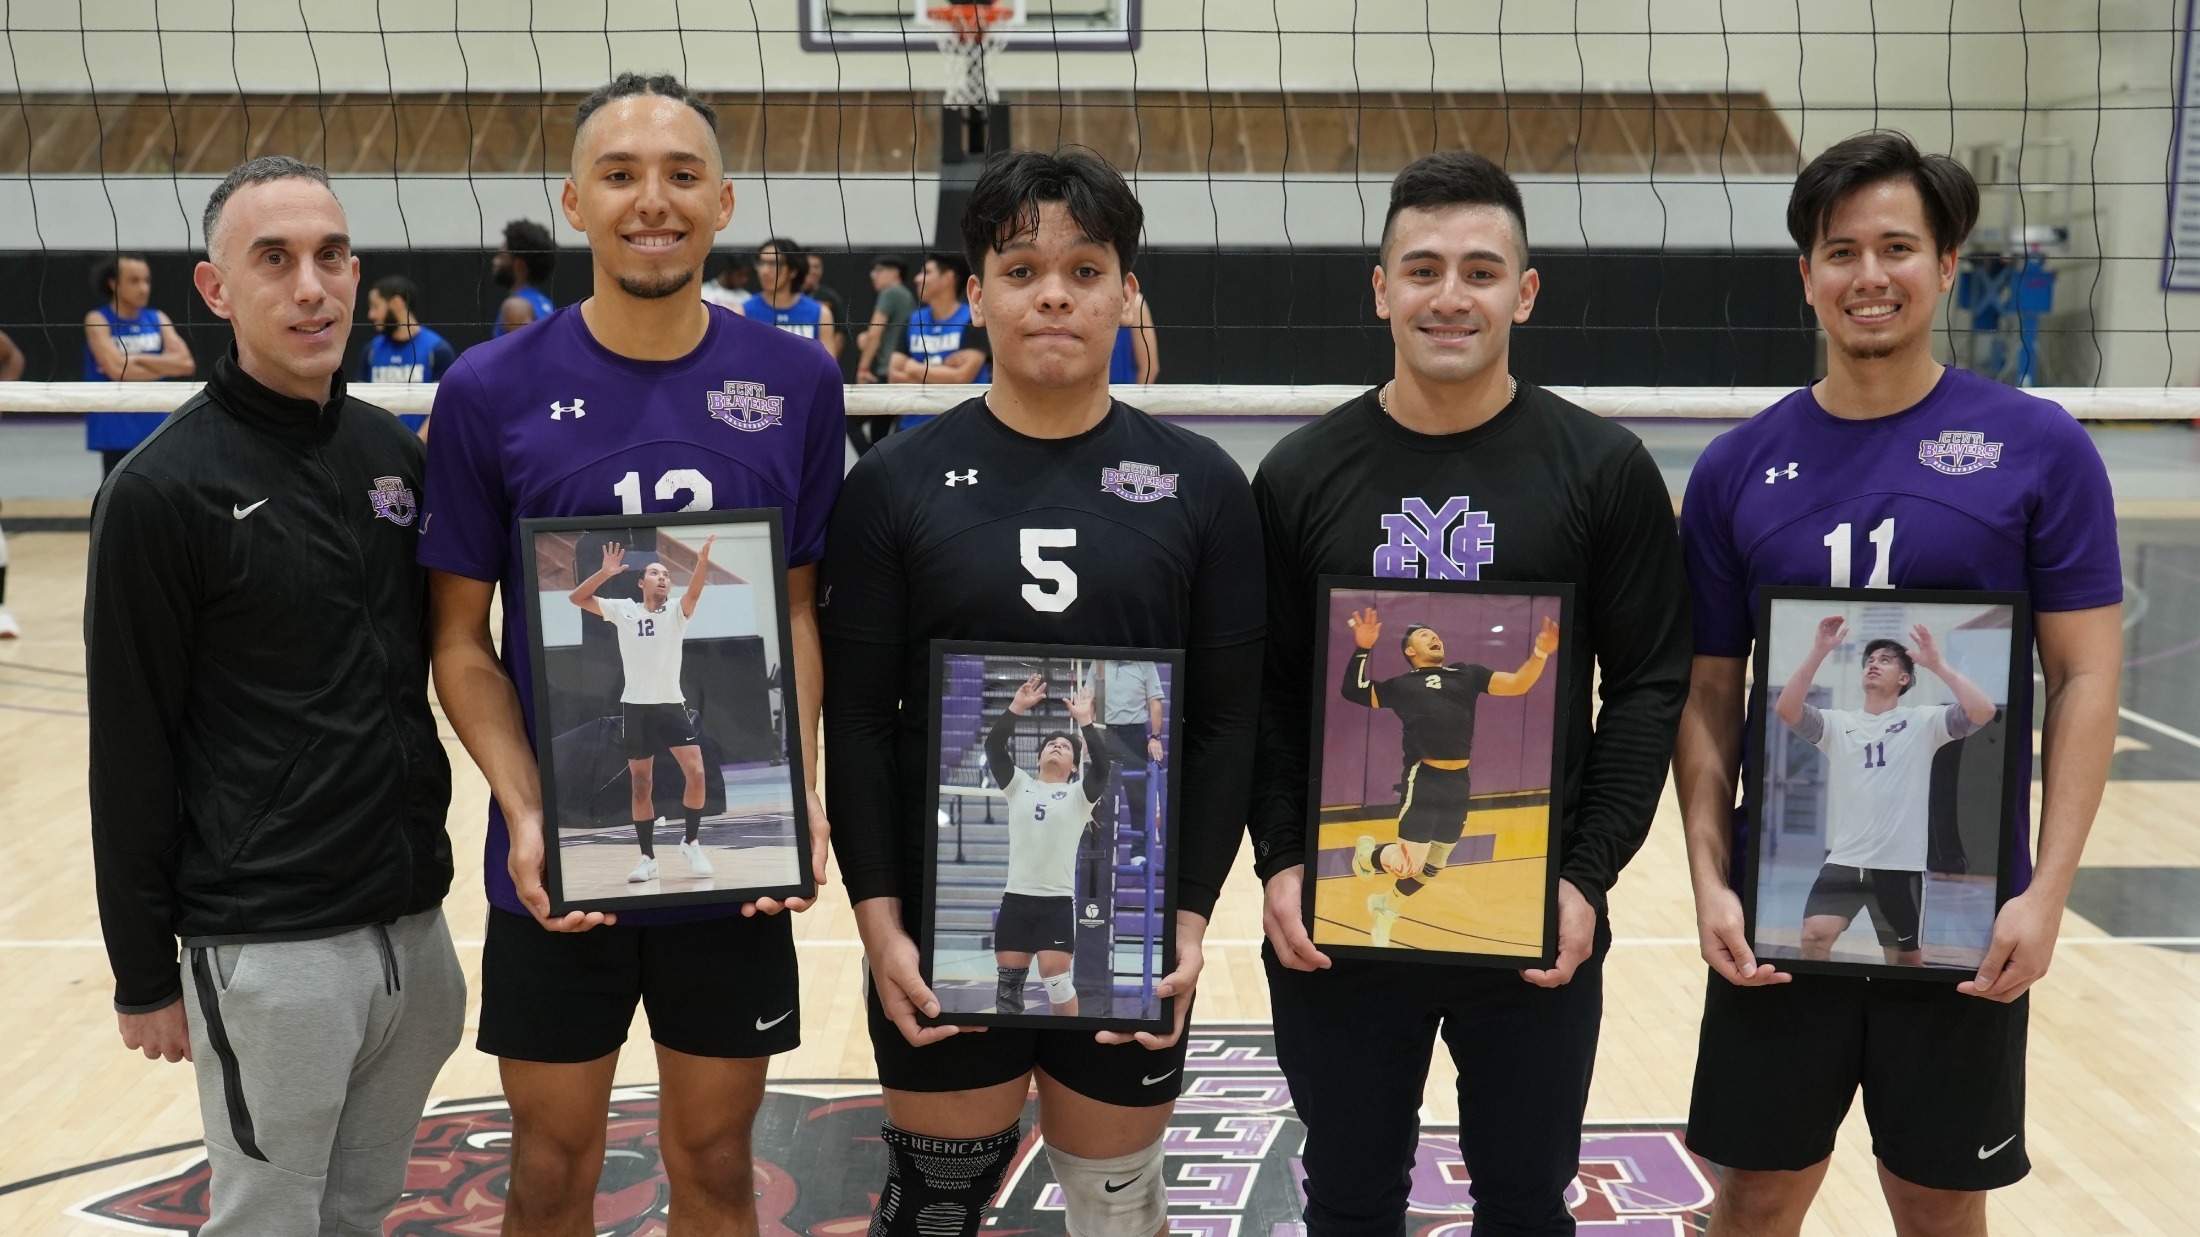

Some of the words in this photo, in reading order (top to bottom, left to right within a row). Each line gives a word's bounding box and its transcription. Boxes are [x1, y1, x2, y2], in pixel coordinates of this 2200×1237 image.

[725, 383, 763, 398] CCNY
[709, 393, 780, 420] BEAVERS
[1941, 432, 1981, 444] CCNY
[1921, 442, 1998, 467] BEAVERS
[1122, 463, 1158, 477] CCNY
[614, 468, 713, 515] 12
[1104, 469, 1175, 495] BEAVERS
[1823, 517, 1896, 590] 11
[1020, 528, 1077, 613] 5
[638, 618, 655, 637] 12
[1425, 674, 1442, 690] 2
[1864, 741, 1886, 769] 11
[1034, 803, 1047, 821] 5
[911, 1136, 984, 1155] NEENCA
